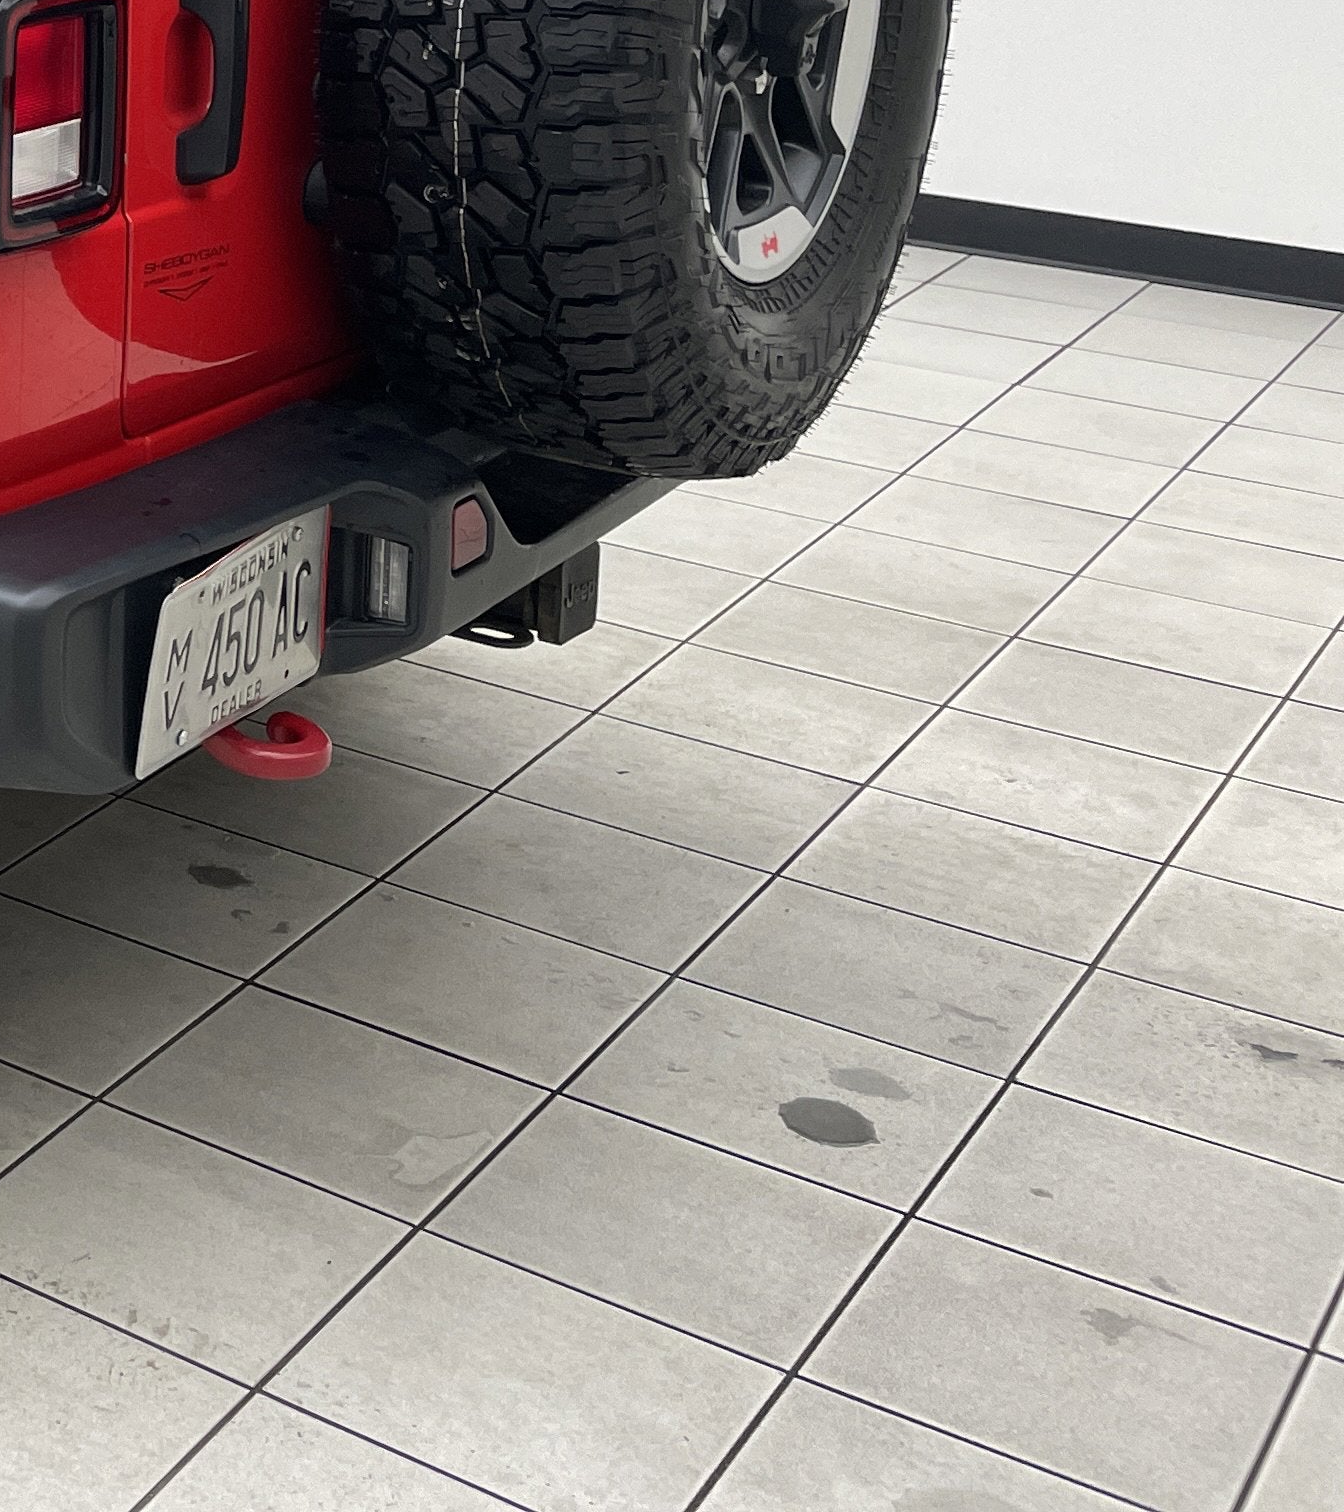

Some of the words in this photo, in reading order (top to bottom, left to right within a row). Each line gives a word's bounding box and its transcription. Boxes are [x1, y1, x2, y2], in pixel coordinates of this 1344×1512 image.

[143, 245, 230, 274] SHEBOYGAN
[212, 531, 289, 605] WISCONSIN
[564, 578, 594, 607] Jeep
[202, 590, 264, 696] 450
[272, 559, 311, 659] AC
[210, 680, 262, 725] DEALER
